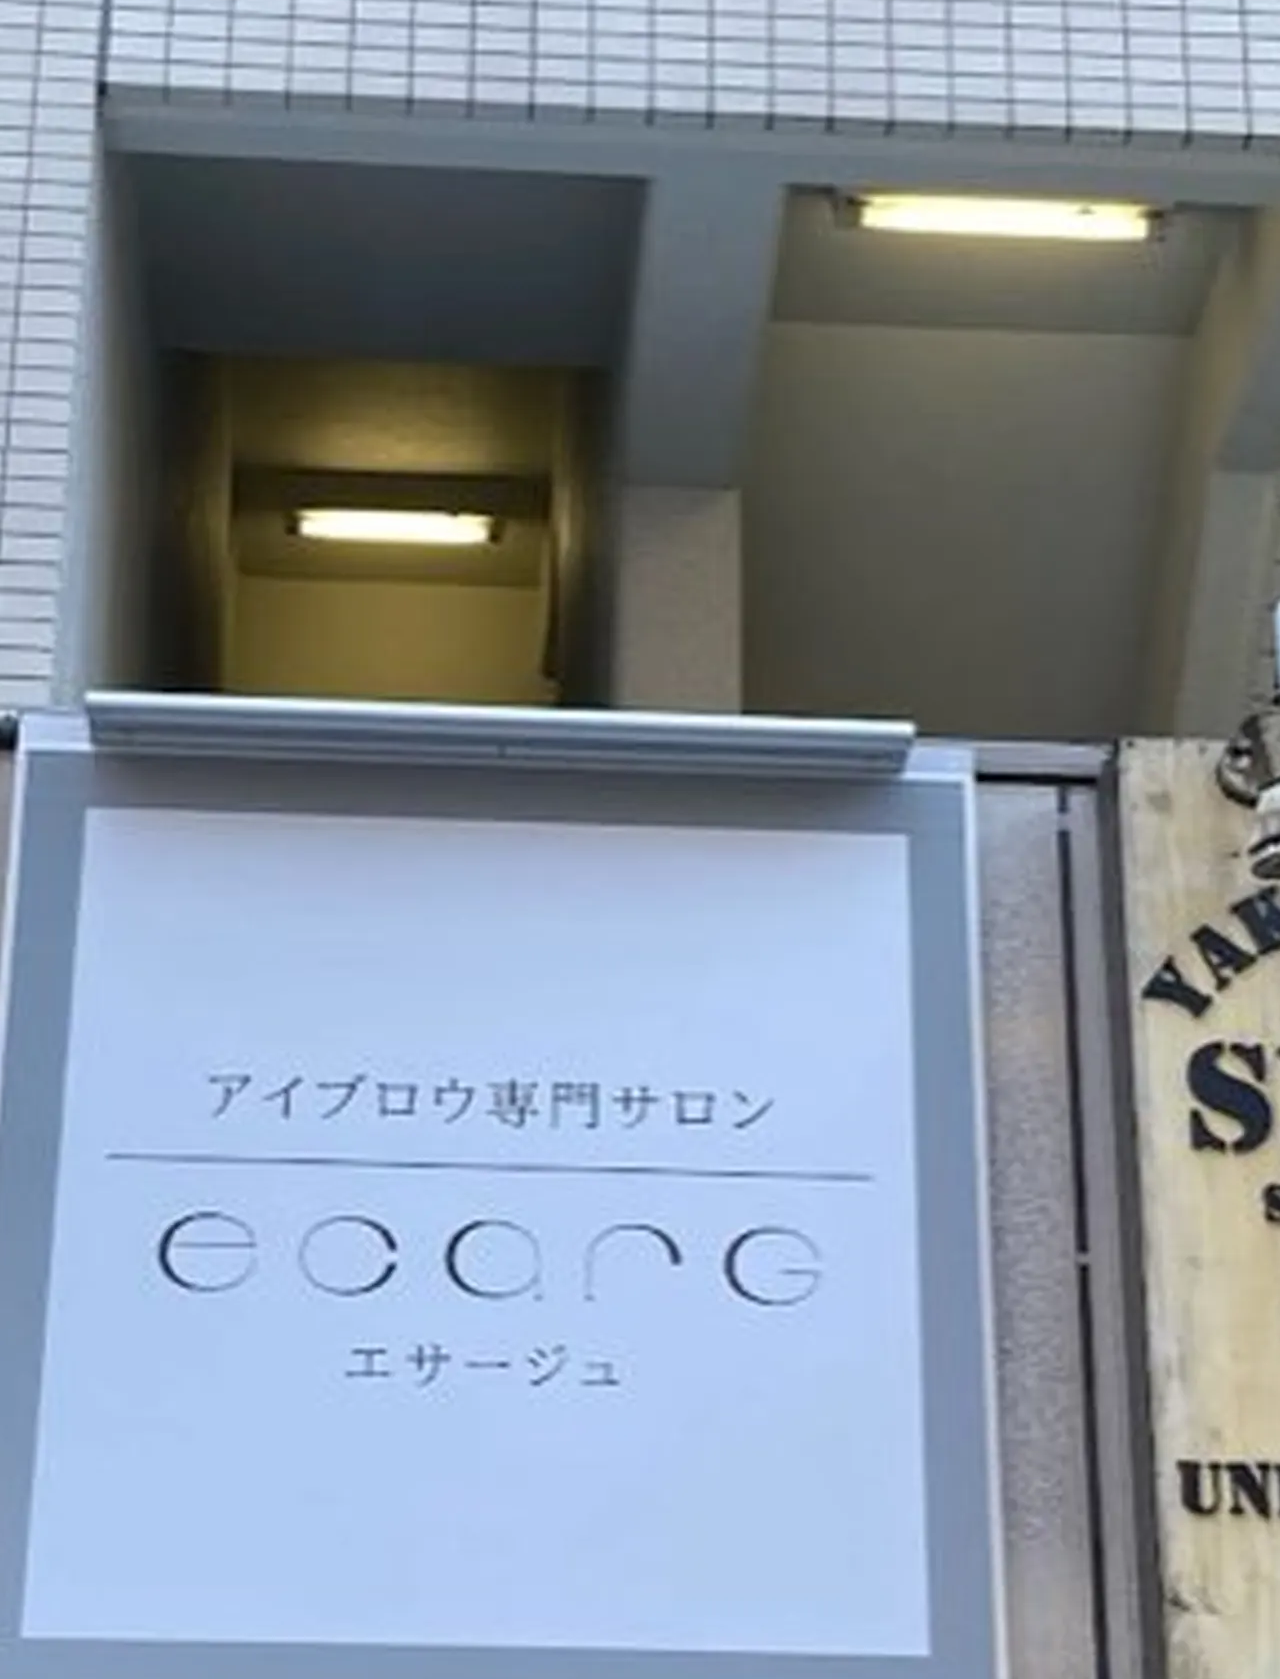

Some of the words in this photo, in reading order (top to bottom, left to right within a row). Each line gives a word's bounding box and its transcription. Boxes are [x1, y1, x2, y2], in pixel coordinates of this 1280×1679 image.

[207, 1071, 774, 1132] アイブロウ専門サロン
[344, 1343, 622, 1389] エサージュ
